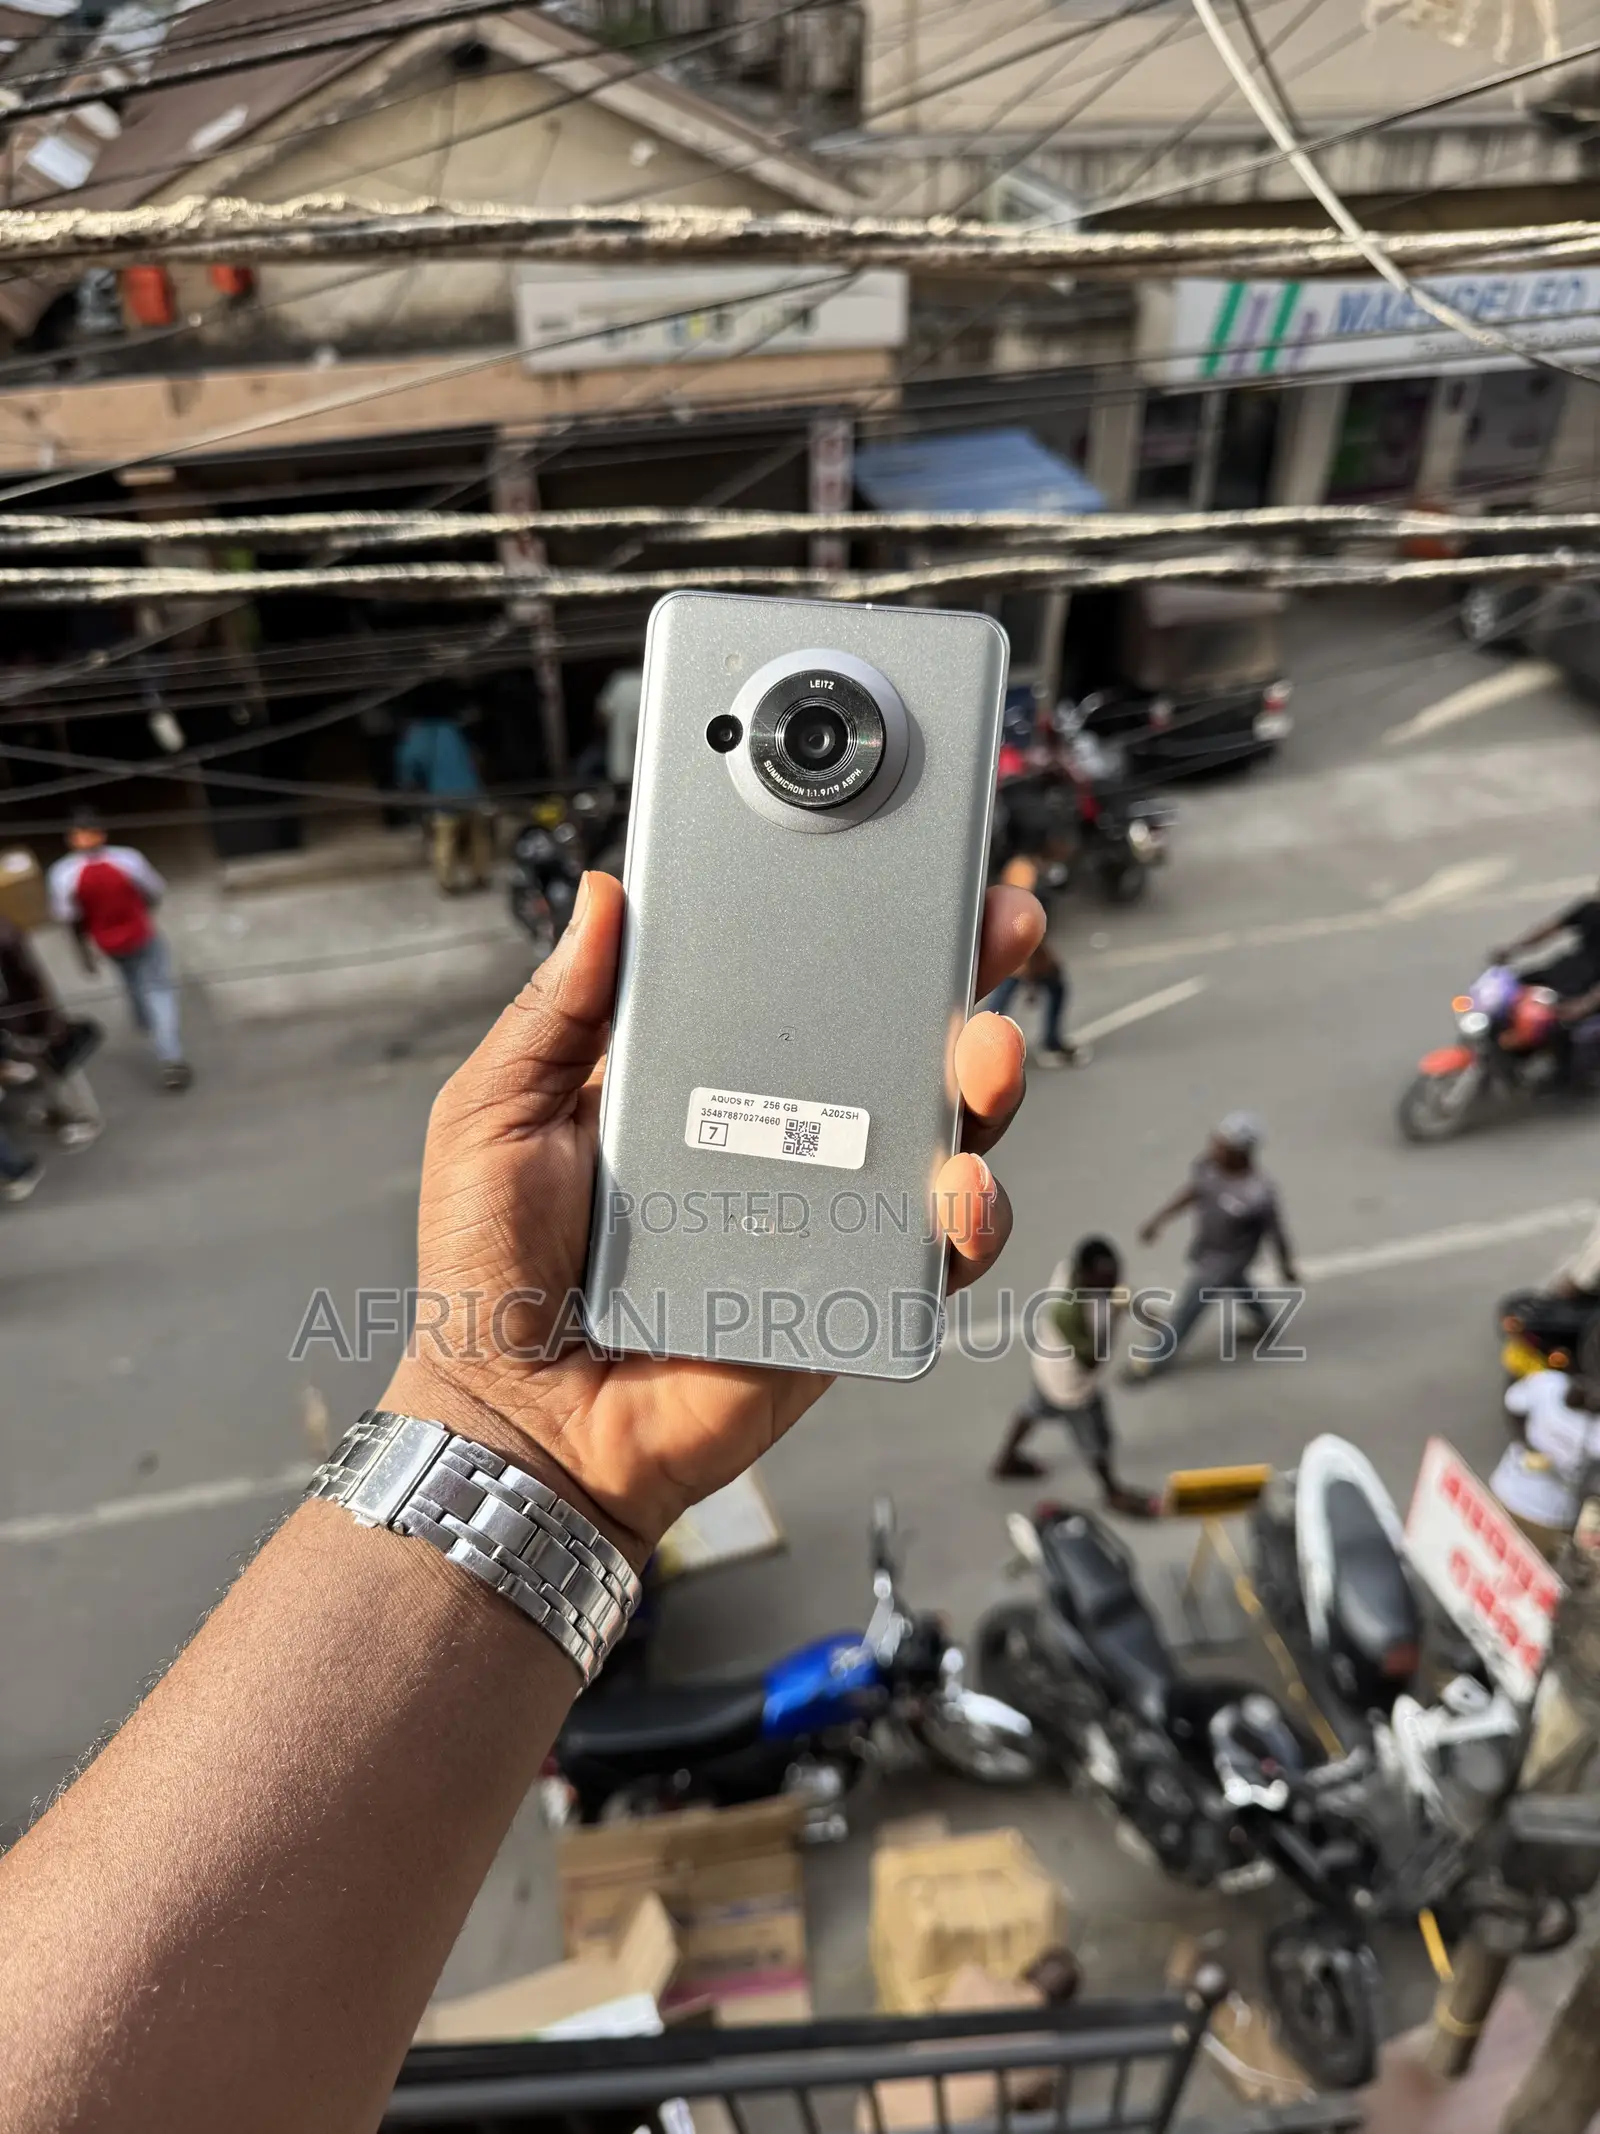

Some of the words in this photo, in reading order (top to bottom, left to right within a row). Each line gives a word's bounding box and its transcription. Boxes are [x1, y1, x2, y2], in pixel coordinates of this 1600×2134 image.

[809, 679, 835, 690] LEITZ
[763, 760, 805, 796] SUMMICRON
[807, 784, 840, 797] 1:1.9/19
[841, 768, 864, 789] ASPH.
[700, 1107, 781, 1126] 354878870274660
[710, 1094, 742, 1106] AQUOS
[743, 1099, 755, 1107] R7
[763, 1100, 781, 1111] 256
[783, 1103, 798, 1113] GB
[820, 1107, 859, 1121] A202SH
[708, 1125, 719, 1140] 7
